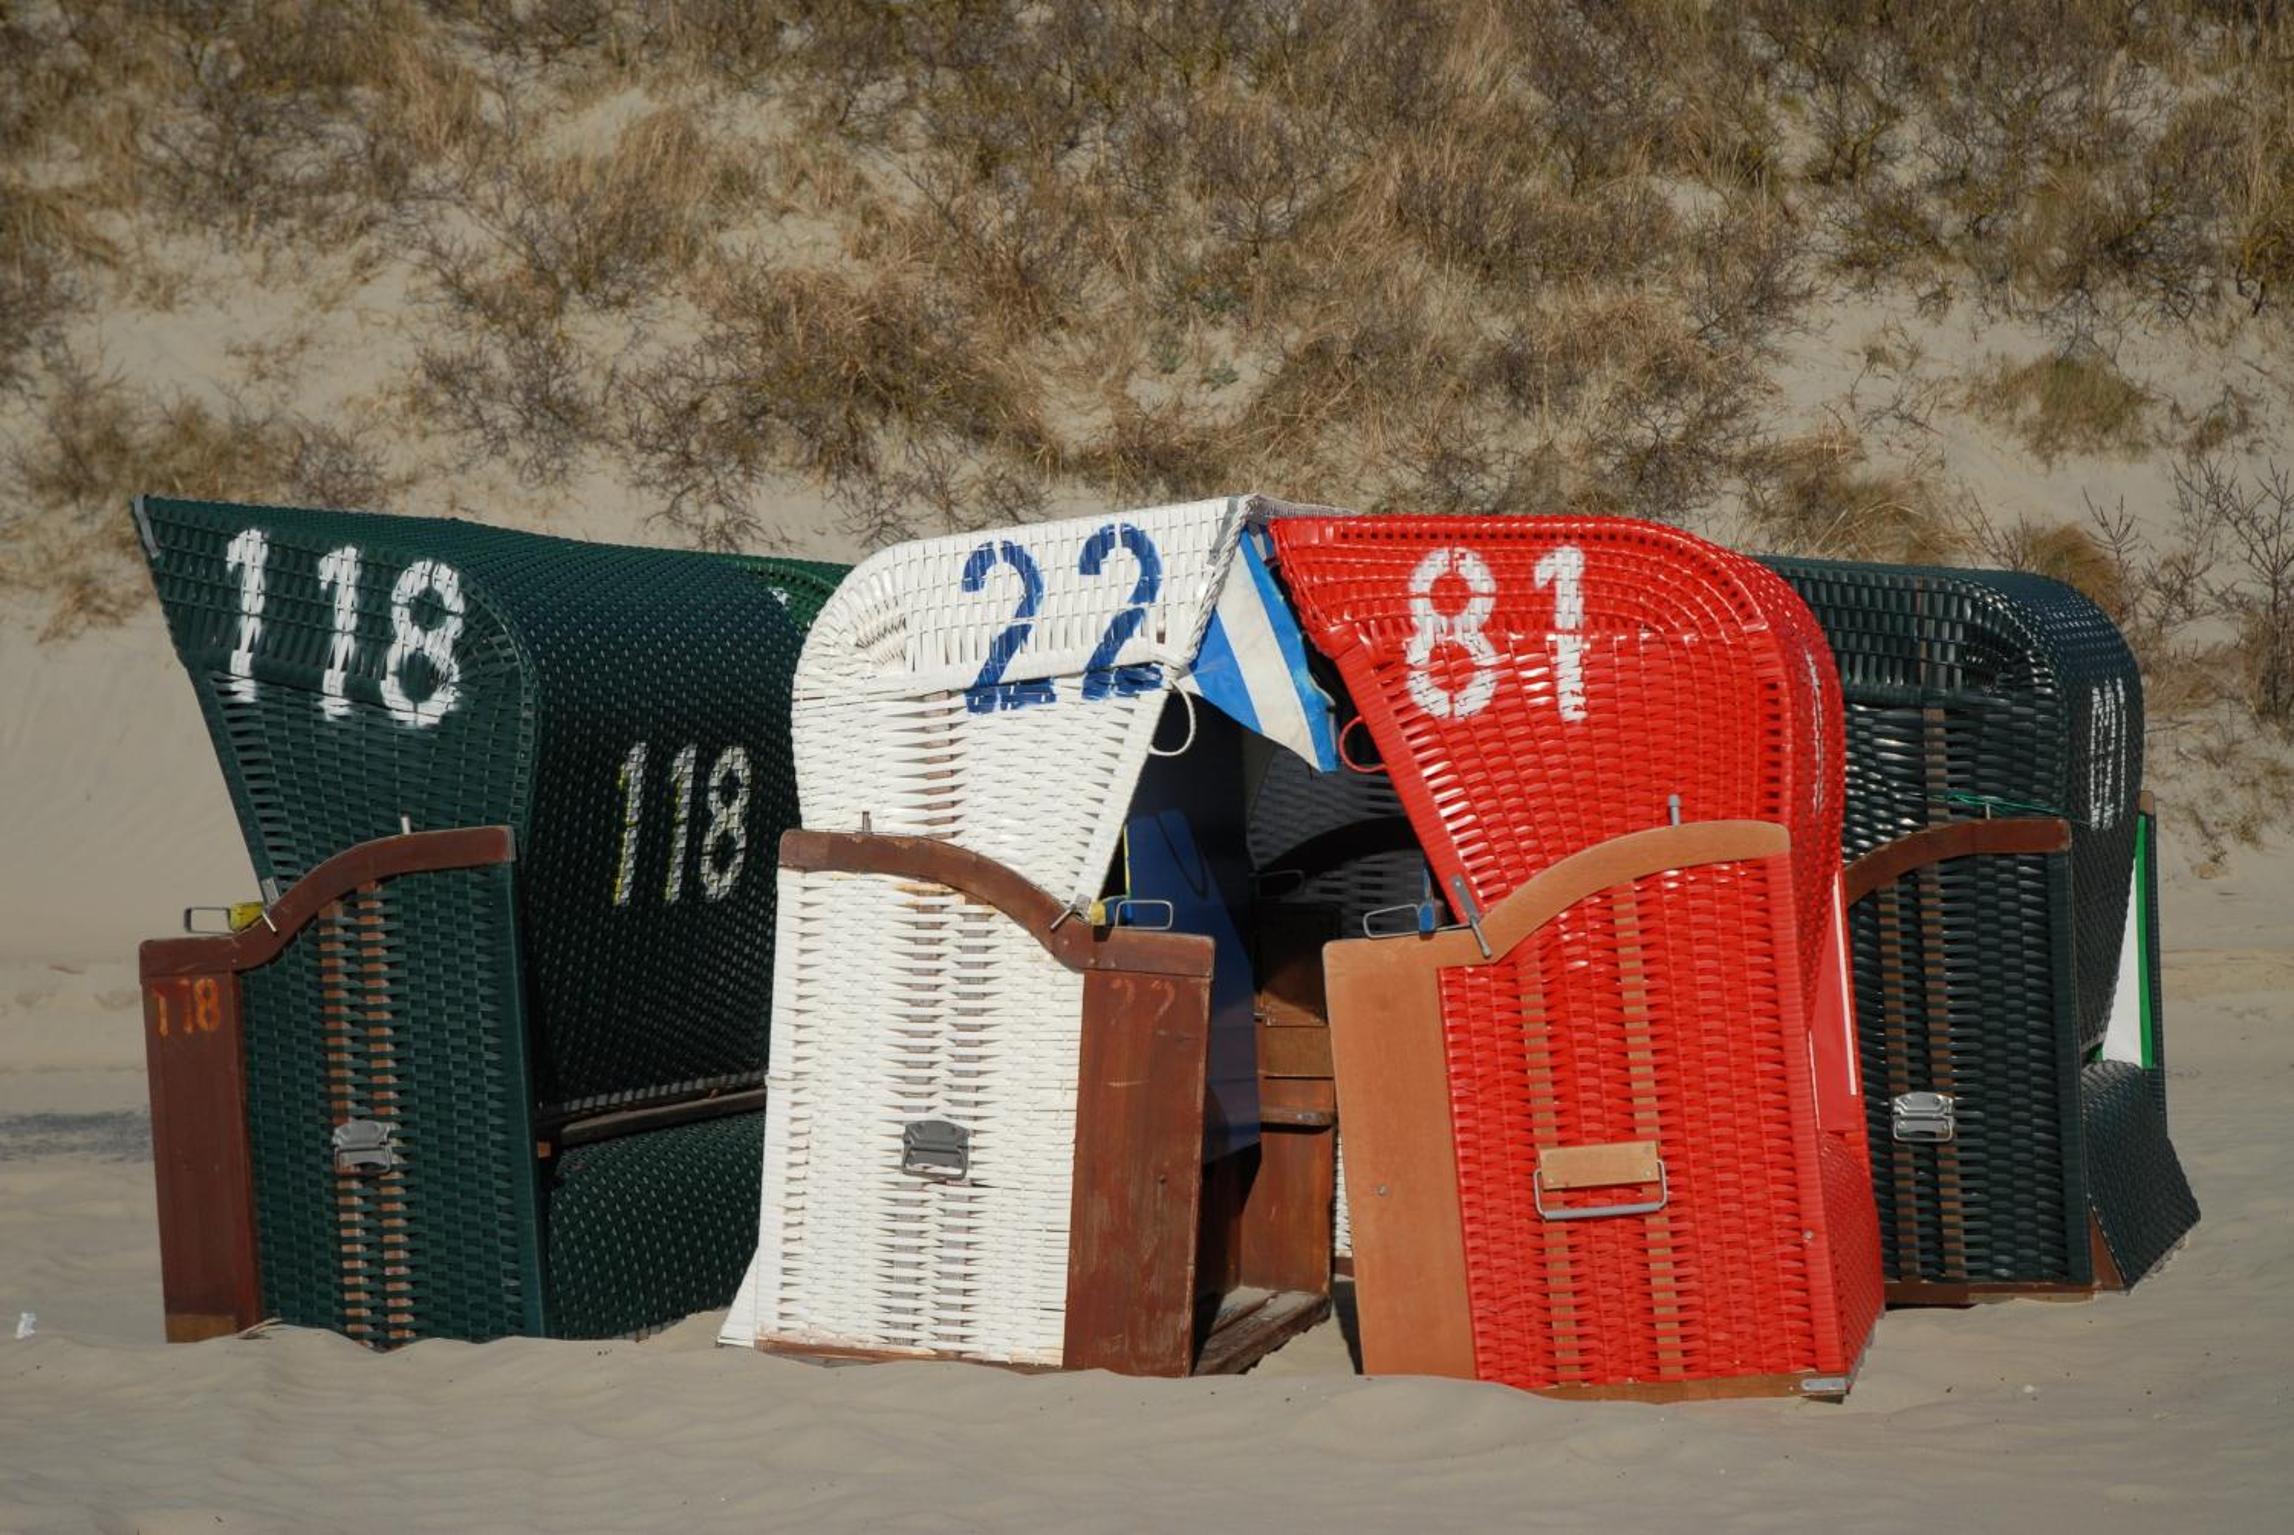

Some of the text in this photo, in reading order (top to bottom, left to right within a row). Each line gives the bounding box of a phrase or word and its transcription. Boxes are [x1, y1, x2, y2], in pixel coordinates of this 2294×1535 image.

[225, 528, 465, 728] 118
[961, 522, 1163, 715] 22
[1405, 544, 1589, 722] 81
[613, 741, 751, 907] 118
[152, 977, 220, 1037] 118
